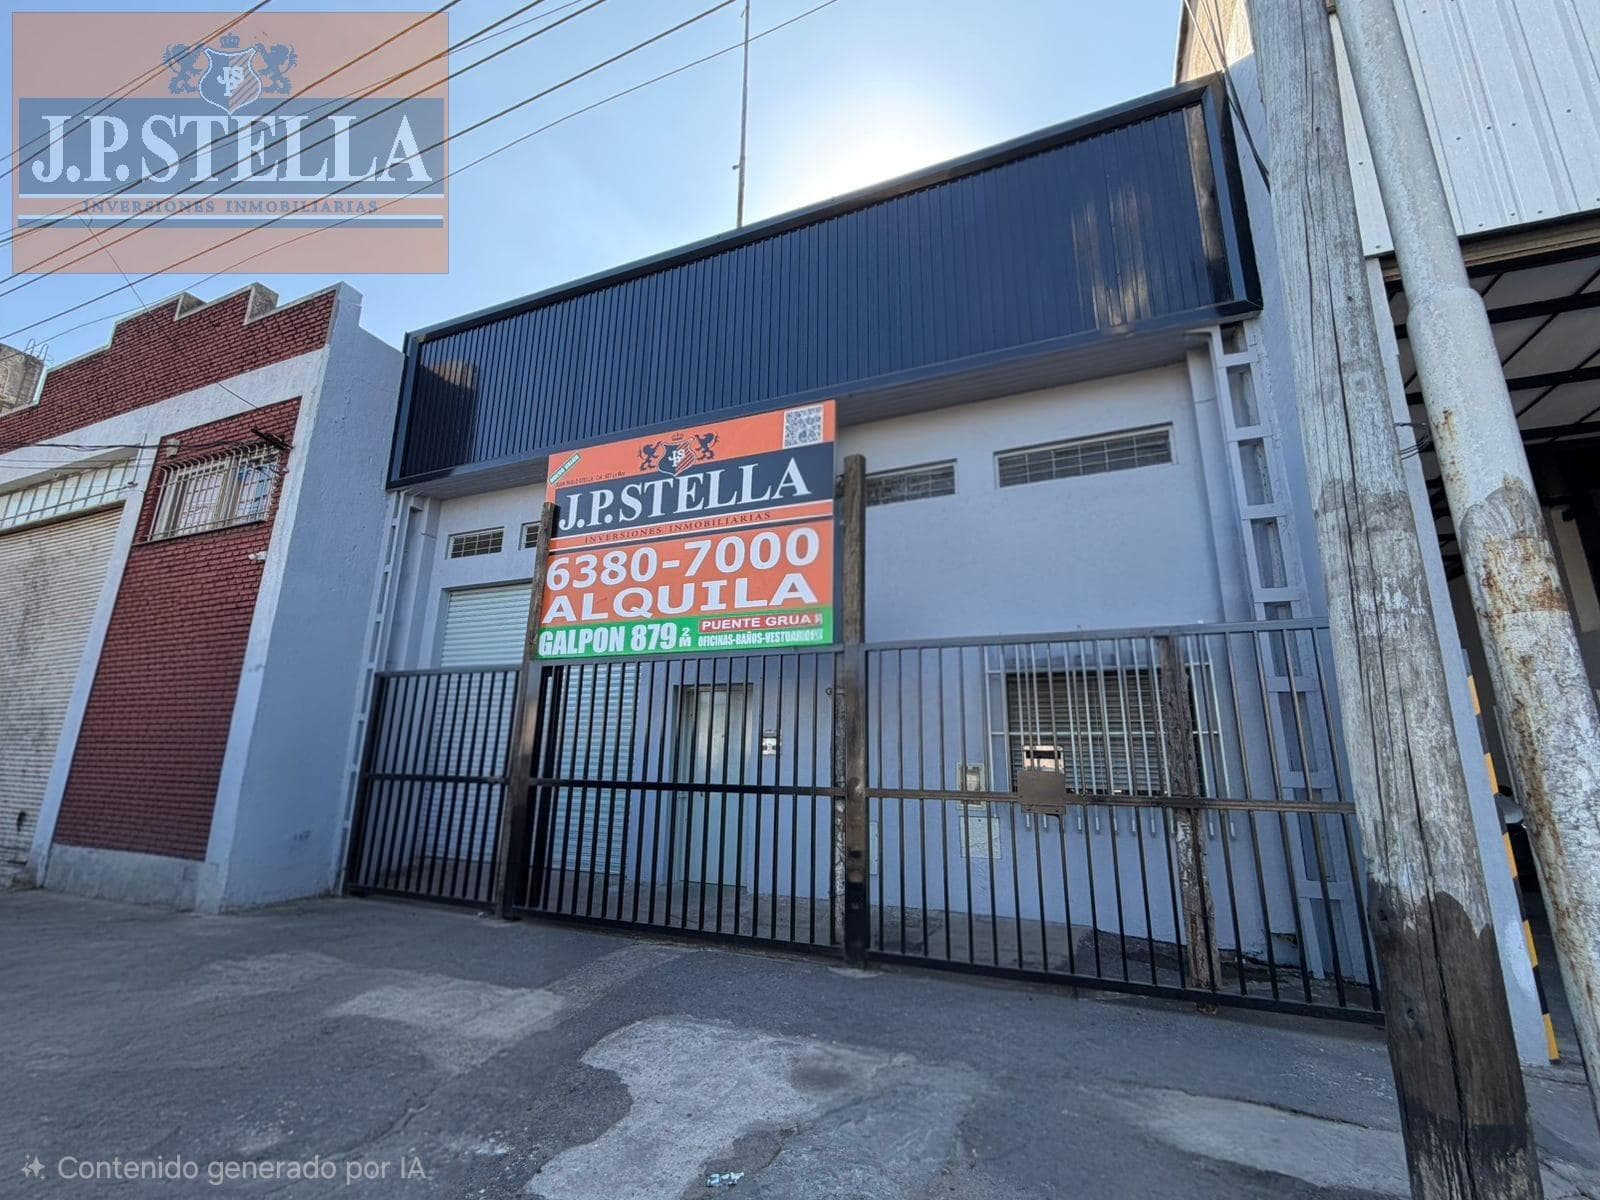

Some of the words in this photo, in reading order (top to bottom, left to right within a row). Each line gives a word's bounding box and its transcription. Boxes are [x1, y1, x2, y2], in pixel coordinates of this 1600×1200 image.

[558, 456, 812, 531] J.P.STELLA
[584, 526, 662, 544] INVERSIONES
[669, 511, 771, 532] INMOBILIARIAS
[546, 527, 820, 591] 6380-7000
[542, 573, 819, 624] ALQUILA
[538, 626, 626, 657] GALPON
[630, 622, 677, 652] 879
[702, 617, 761, 631] PUENTE
[765, 613, 811, 627] GRUA
